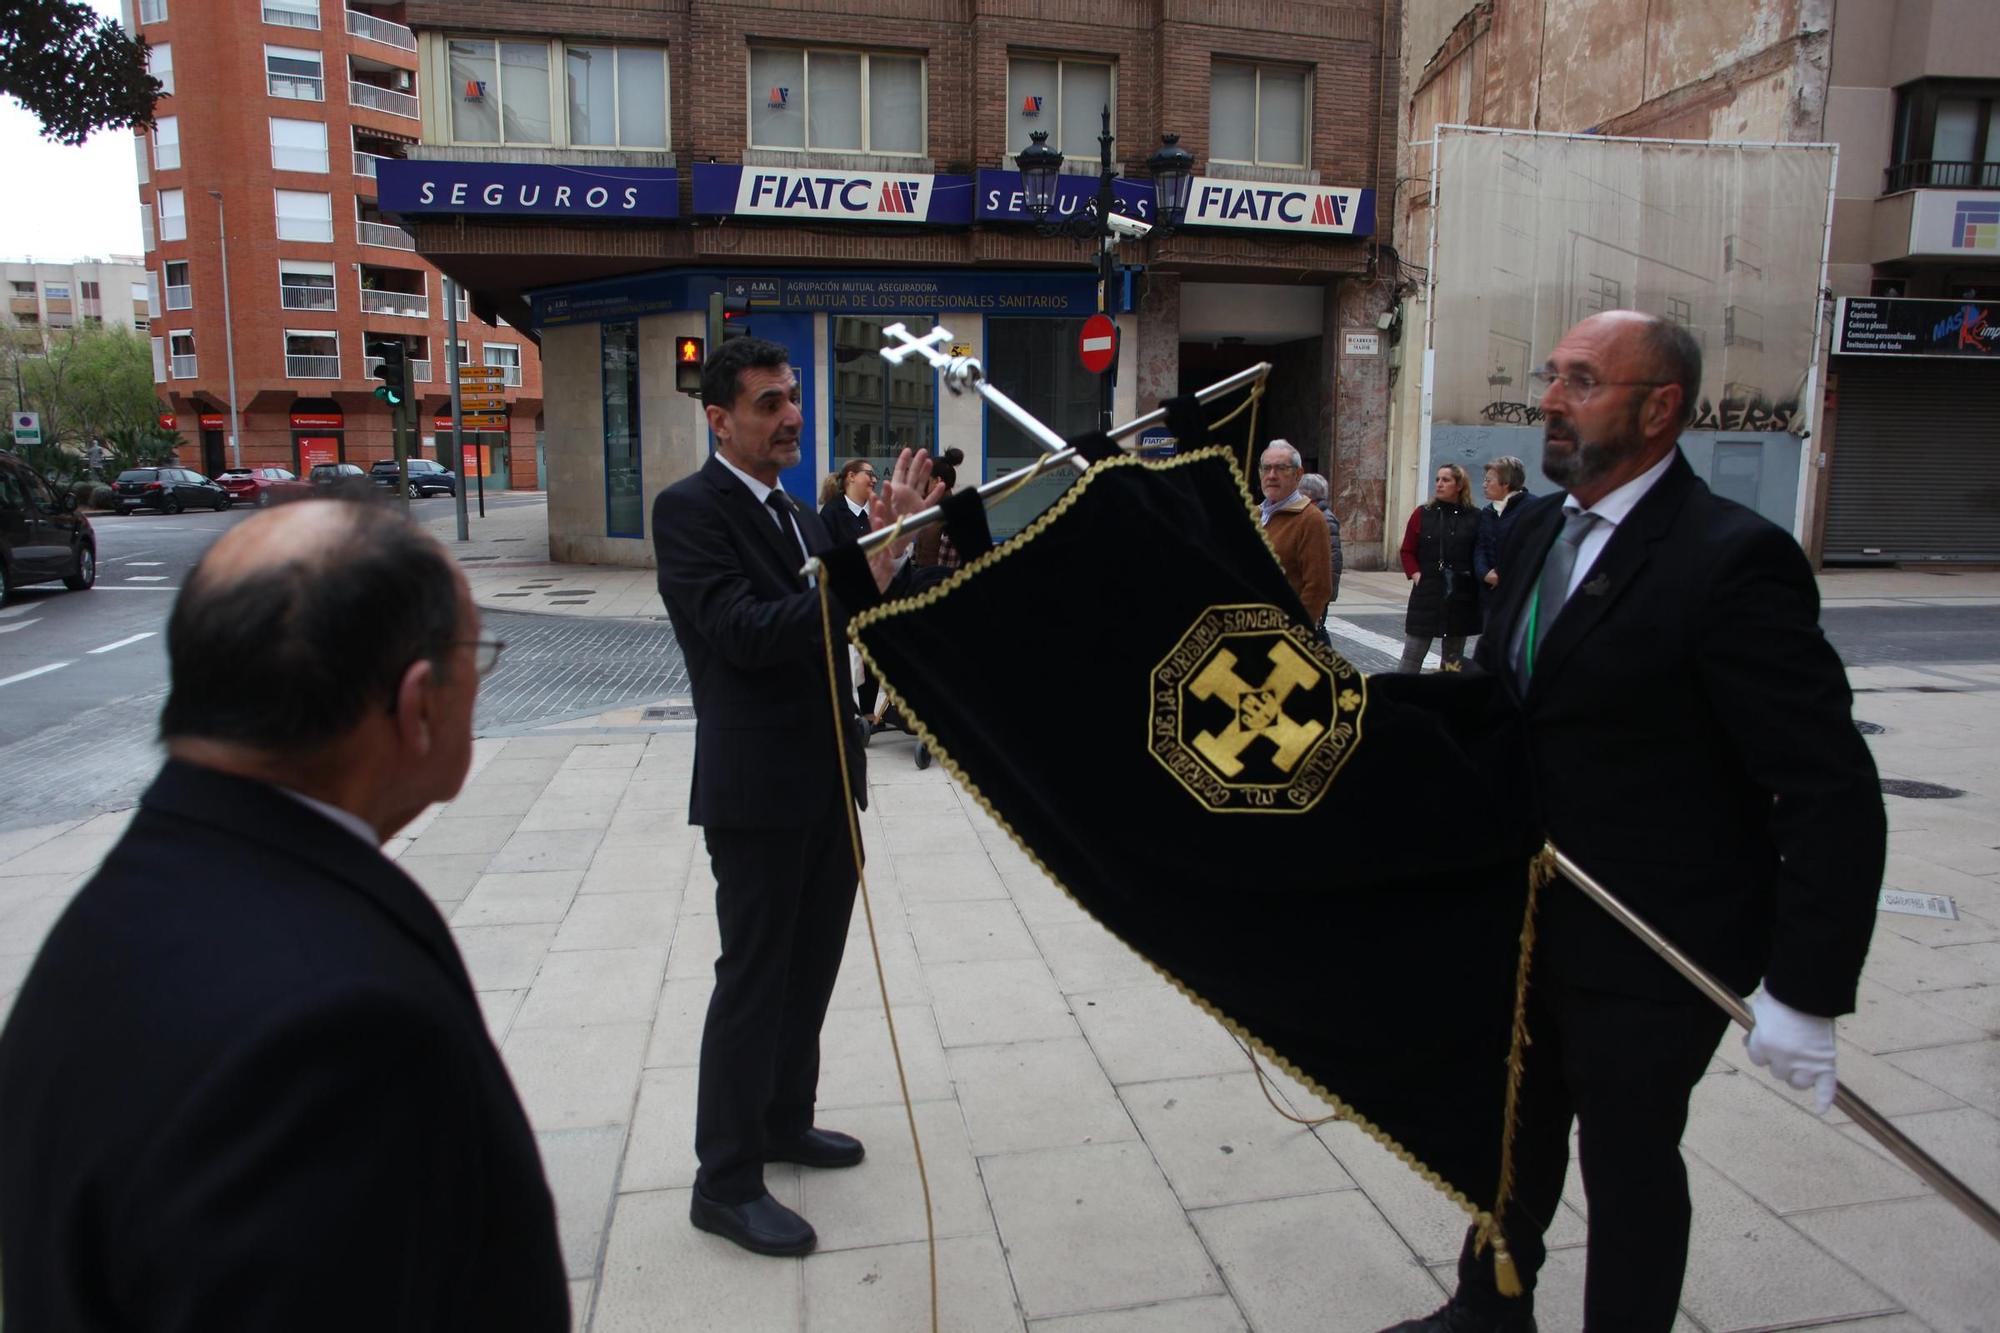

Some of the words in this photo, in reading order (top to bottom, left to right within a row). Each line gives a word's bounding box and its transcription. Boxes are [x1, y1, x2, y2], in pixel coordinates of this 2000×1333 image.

[419, 182, 639, 209] SEGUROS
[749, 175, 873, 211] FIATC
[1197, 187, 1307, 223] FIATC
[787, 280, 840, 291] AGRUPACIÓN
[842, 283, 874, 292] MUTUAL
[878, 283, 938, 292] ASEGURADORA
[787, 294, 801, 306] LA
[805, 294, 847, 306] MUTUA
[852, 295, 867, 306] DE
[872, 295, 895, 307] LOS
[900, 295, 994, 307] PROFESIONALES
[999, 295, 1069, 308] SANITARIOS
[1847, 331, 1875, 339] Camisetas
[1875, 332, 1916, 341] personalizadas
[1222, 609, 1290, 634] SANGRE
